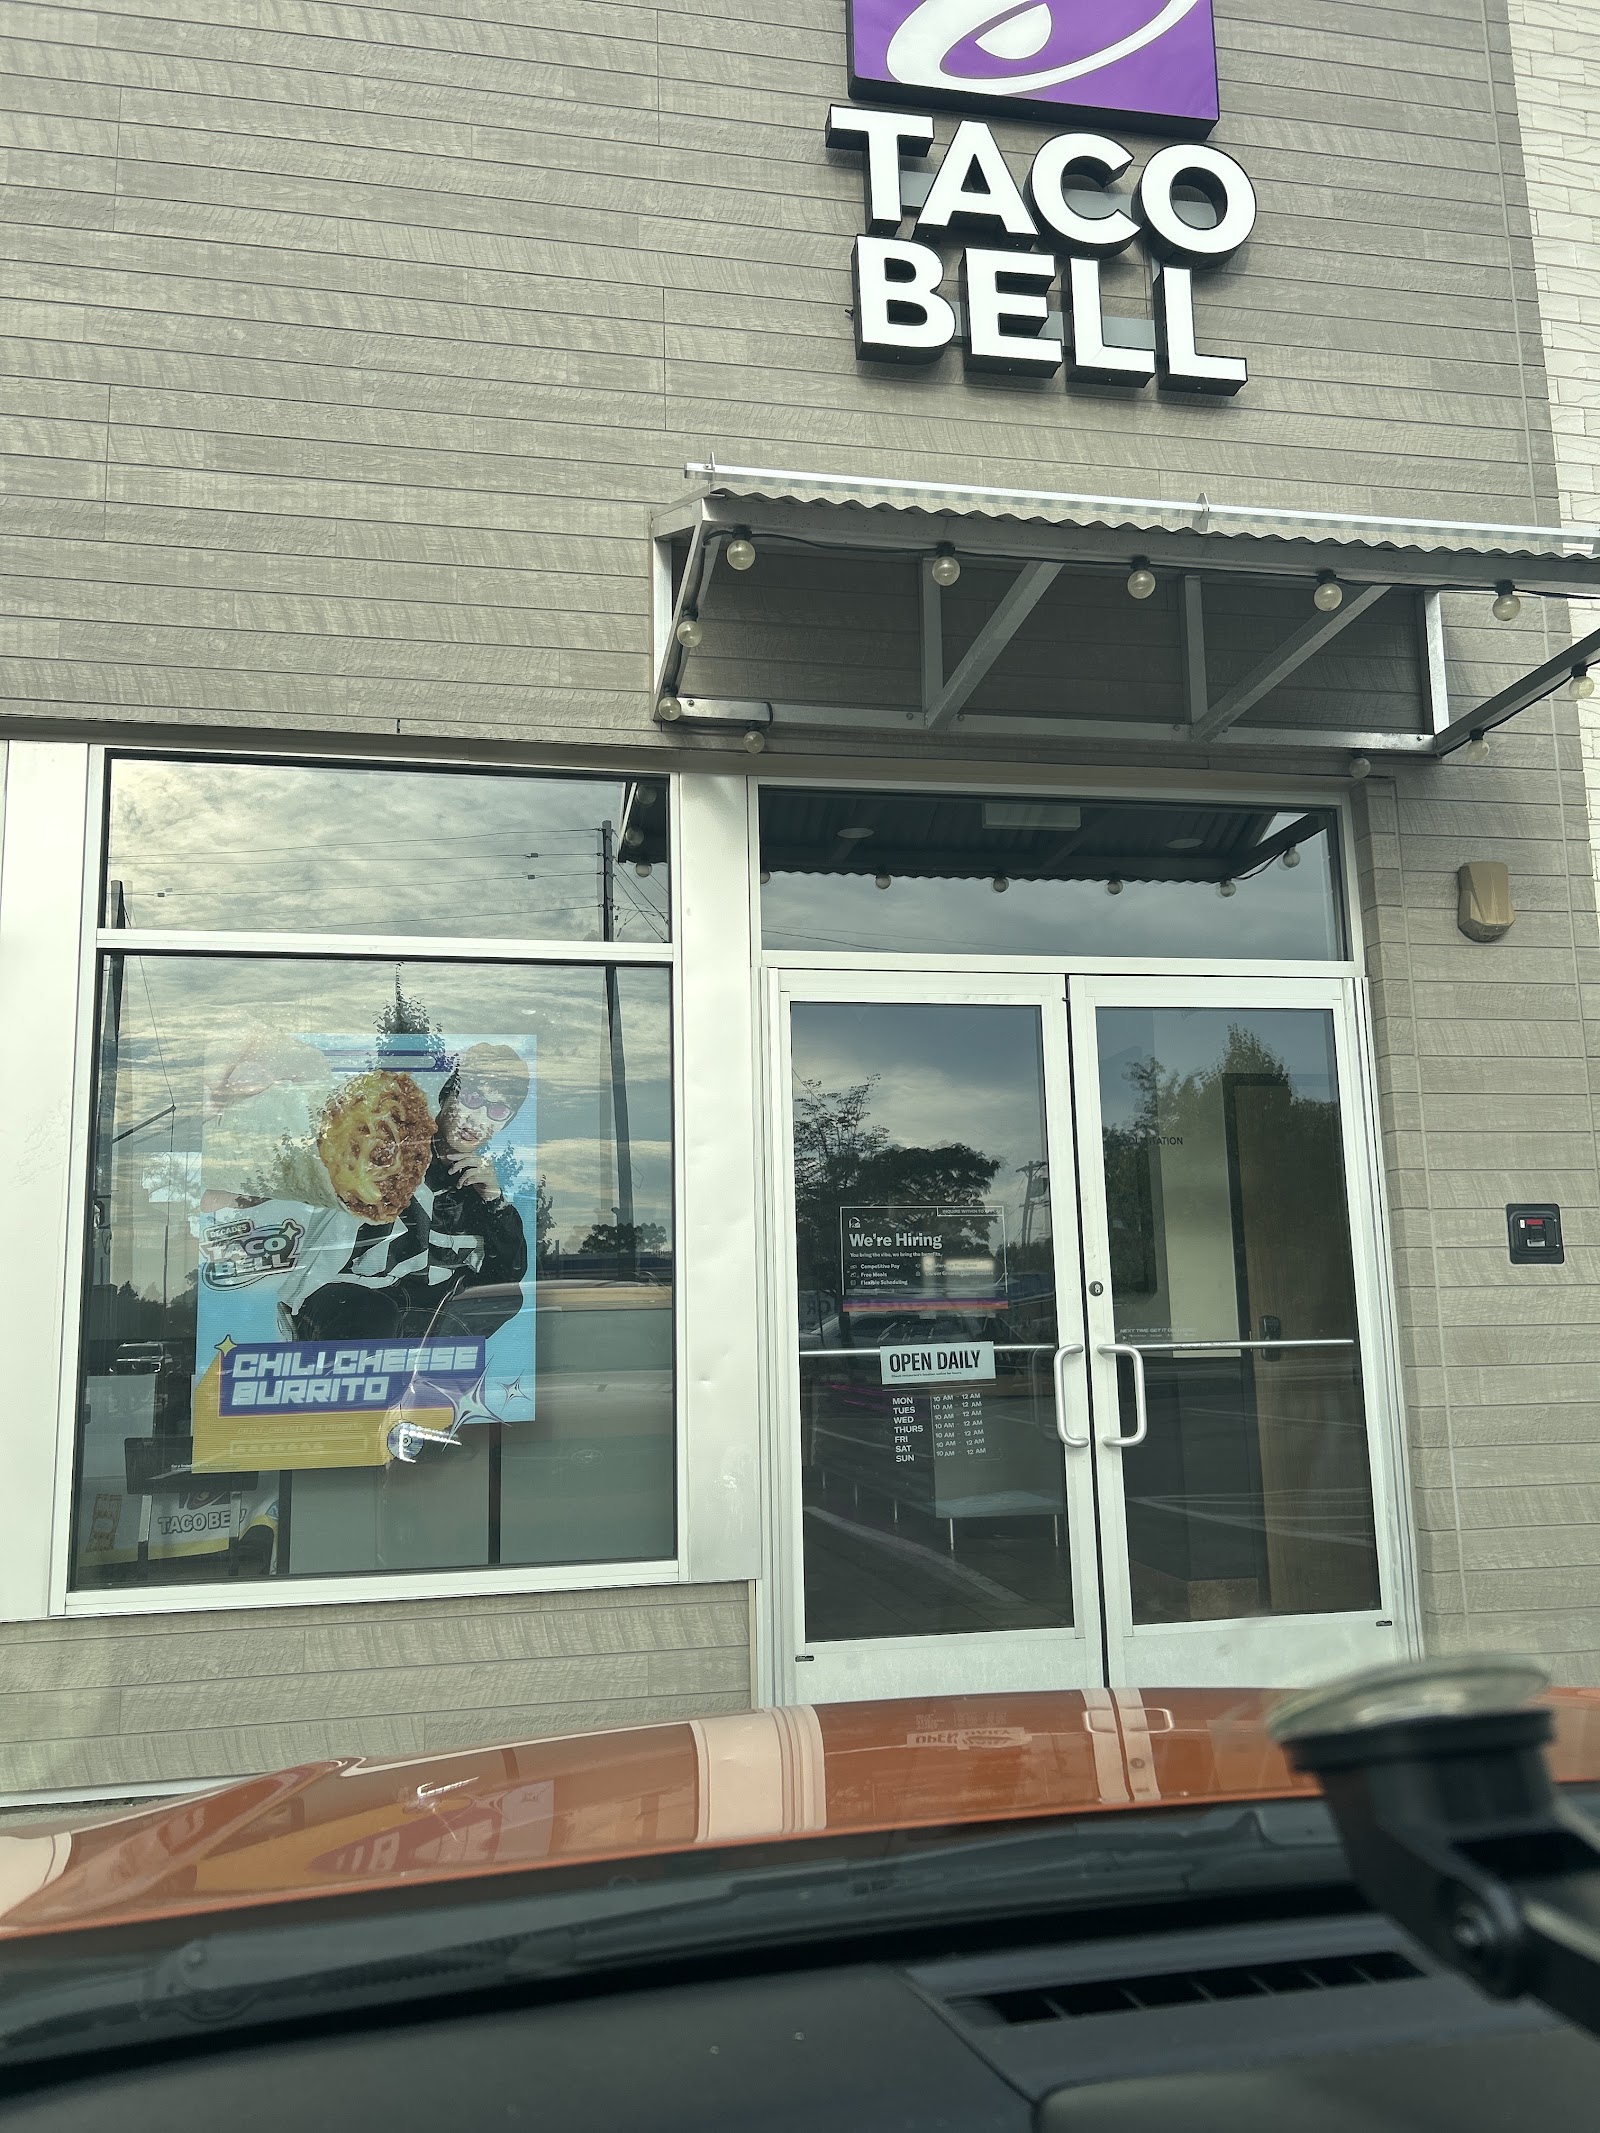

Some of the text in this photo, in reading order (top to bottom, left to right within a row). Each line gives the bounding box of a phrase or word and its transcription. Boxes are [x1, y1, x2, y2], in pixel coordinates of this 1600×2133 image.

[826, 104, 1257, 260] TACO
[853, 234, 1248, 390] BELL
[210, 1223, 248, 1238] DECADES
[849, 1232, 943, 1250] We're Hiring
[205, 1236, 287, 1261] TACO
[232, 1345, 479, 1379] CHILI CHEESE
[889, 1349, 981, 1373] OPEN DAILY
[231, 1376, 390, 1406] BURRITO
[892, 1397, 914, 1405] MON
[893, 1406, 916, 1414] TUES
[894, 1426, 924, 1434] THURS
[158, 1512, 207, 1535] TACO
